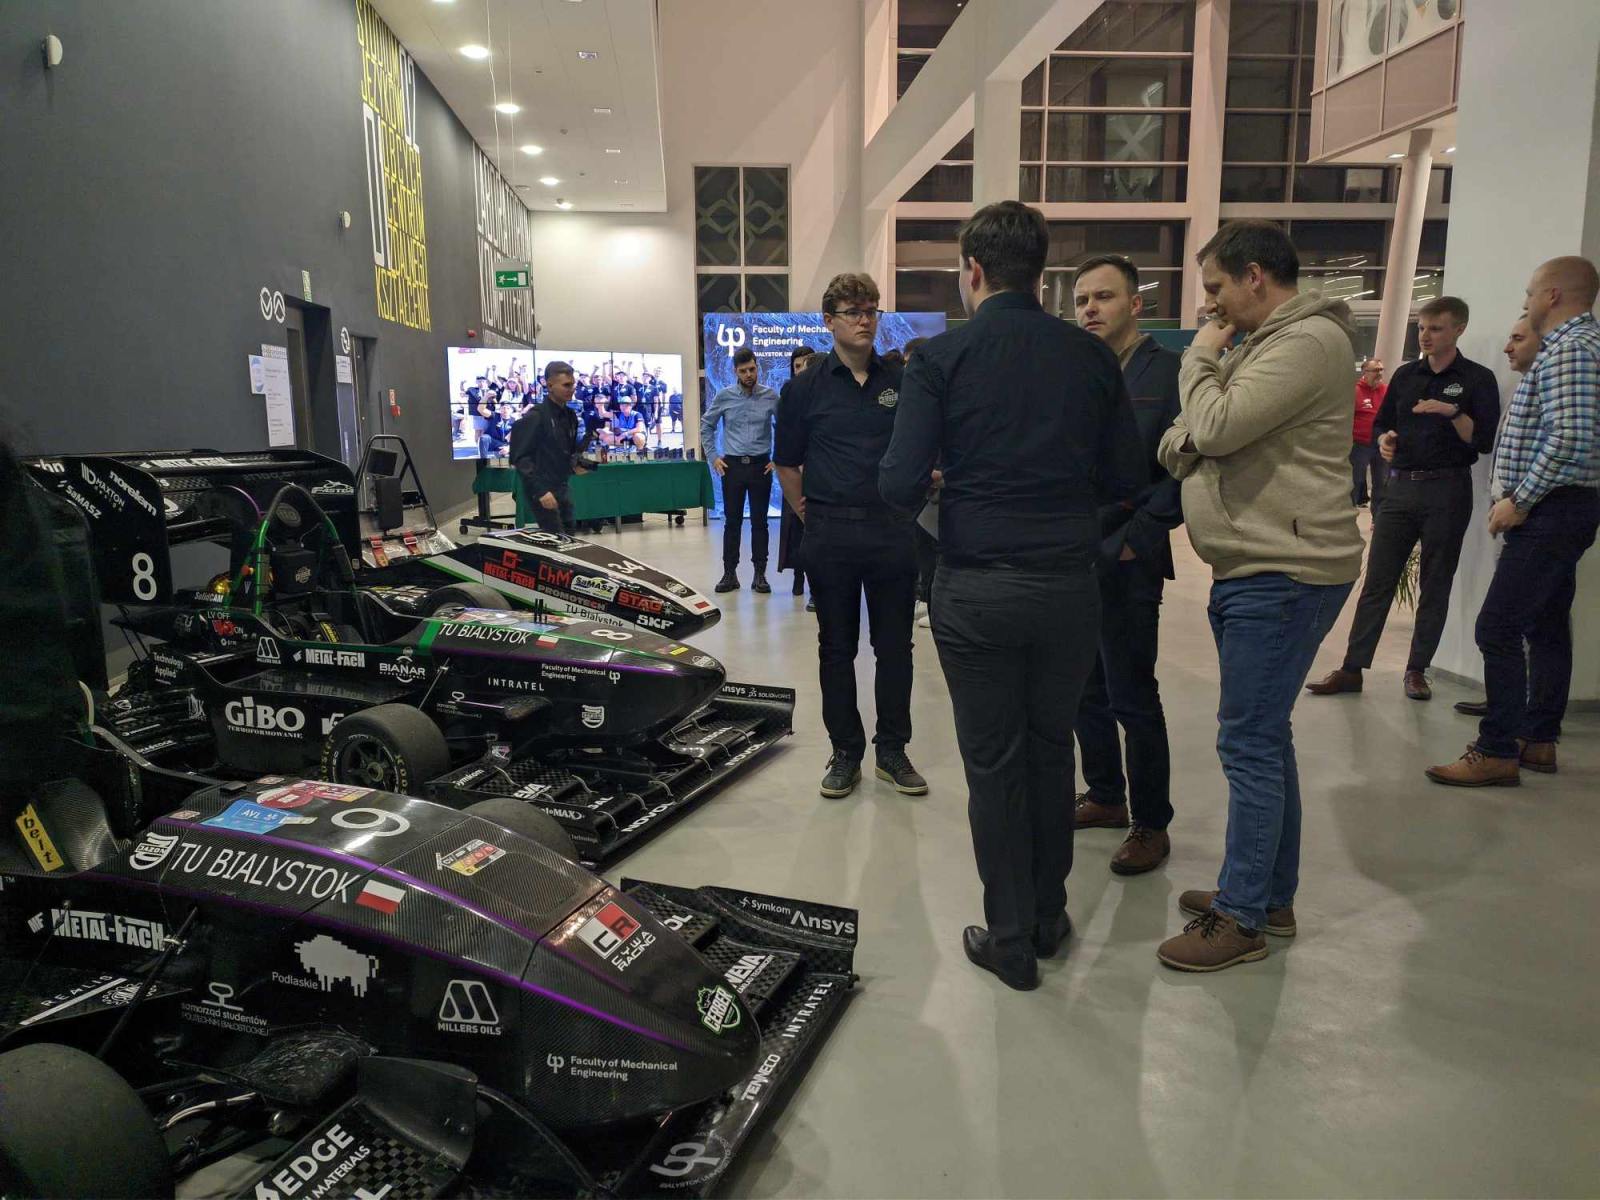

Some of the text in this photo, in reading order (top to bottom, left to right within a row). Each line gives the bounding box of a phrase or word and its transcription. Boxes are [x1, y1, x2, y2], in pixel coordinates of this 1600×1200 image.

[752, 325, 785, 335] Faculty
[786, 325, 796, 333] of
[752, 337, 804, 347] Engineering
[65, 485, 102, 519] SaMASZ
[95, 478, 125, 507] MAXTON
[132, 552, 157, 601] 8
[608, 560, 645, 574] 34
[575, 577, 614, 593] SaMASZ
[566, 604, 578, 615] TU
[619, 591, 664, 613] STAG
[637, 615, 674, 630] SKF
[438, 623, 532, 644] TU BIALYSTOK
[305, 648, 366, 668] METAL-FACH
[379, 662, 426, 676] BIANAR
[541, 663, 564, 673] Faculty
[571, 666, 606, 676] Mechanical
[541, 671, 577, 681] Engineering
[488, 677, 545, 692] INTRATEL
[722, 685, 746, 696] nsys
[620, 800, 677, 832] NOVOL
[23, 818, 53, 863] belt
[170, 843, 361, 904] TU BIALYSTOK
[751, 899, 791, 915] Symkom
[50, 908, 165, 952] METAL-FACH
[790, 911, 856, 936] Ansys
[617, 934, 656, 971] RACING
[272, 971, 318, 990] Podlaskie
[704, 987, 733, 1031] CERBER
[782, 981, 833, 1038] INTRATEL
[437, 1022, 502, 1036] MILLERS OILS
[570, 1055, 678, 1071] Faculty of Mechanical
[570, 1067, 629, 1081] Engineering
[741, 1053, 781, 1101] TENNECO
[311, 1145, 371, 1199] MATERIALS
